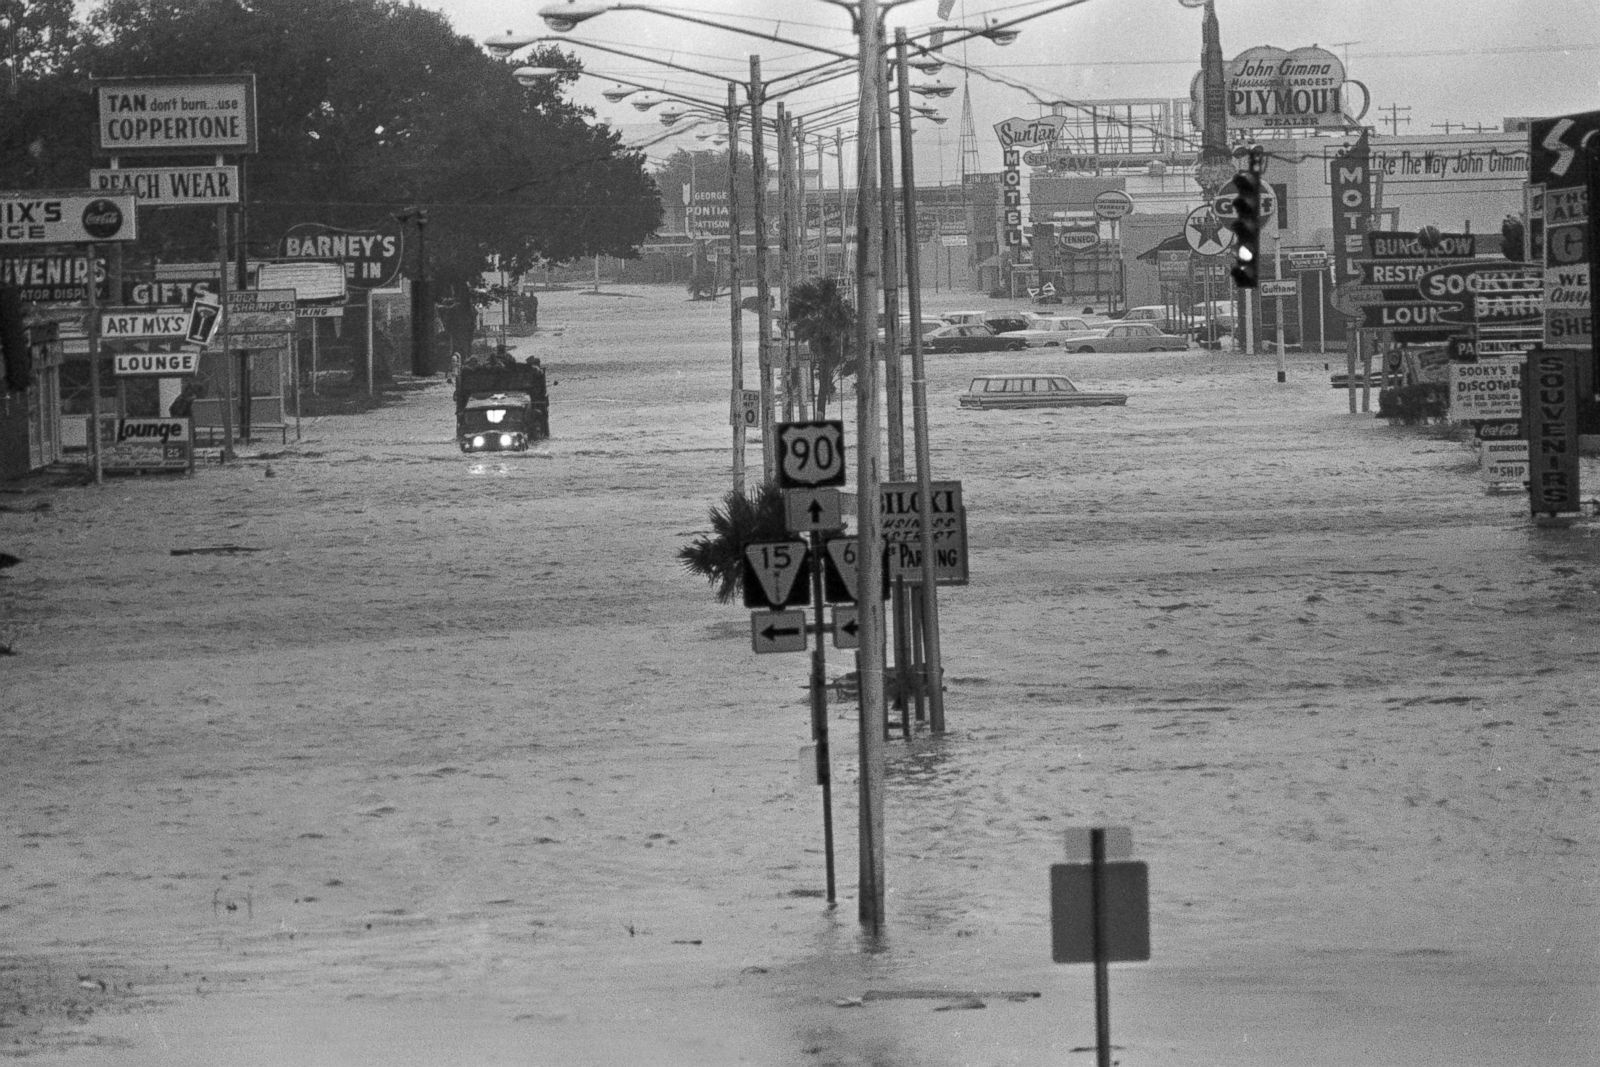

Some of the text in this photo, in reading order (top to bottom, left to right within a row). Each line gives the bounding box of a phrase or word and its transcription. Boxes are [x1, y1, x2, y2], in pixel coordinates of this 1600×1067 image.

[1235, 58, 1332, 77] John Gimma
[1288, 78, 1335, 86] LARGEST
[108, 95, 146, 112] TAN
[150, 97, 178, 112] don't
[107, 115, 239, 140] COPPERTONE
[1264, 118, 1319, 126] DEALER
[1401, 151, 1421, 175] The
[1425, 150, 1449, 179] Way
[1453, 150, 1483, 174] John
[170, 172, 231, 198] WEAR
[694, 192, 729, 200] GEORGE
[1005, 152, 1020, 244] MOTEL
[0, 201, 61, 223] IX'S
[686, 207, 729, 216] PONTIA
[1215, 197, 1273, 214] Gf
[1339, 166, 1364, 275] MOTEL
[287, 234, 396, 258] BARNEY'S
[1064, 235, 1095, 243] TENNECO
[1375, 238, 1473, 256] BUNGLOW
[362, 262, 382, 279] IN
[1558, 273, 1588, 287] WE
[54, 287, 103, 299] DISPLY
[132, 282, 210, 304] GIFTS
[1383, 306, 1448, 324] LOUN
[106, 317, 139, 334] ART
[142, 316, 185, 334] MIX'S
[118, 356, 192, 371] LOUNGE
[1459, 366, 1506, 377] SOOKY'S
[745, 409, 755, 423] 0
[1540, 356, 1569, 504] SOUVENIRS
[791, 435, 833, 470] 90
[1500, 466, 1525, 477] SHIP
[762, 545, 791, 570] 15
[843, 542, 856, 565] 6
